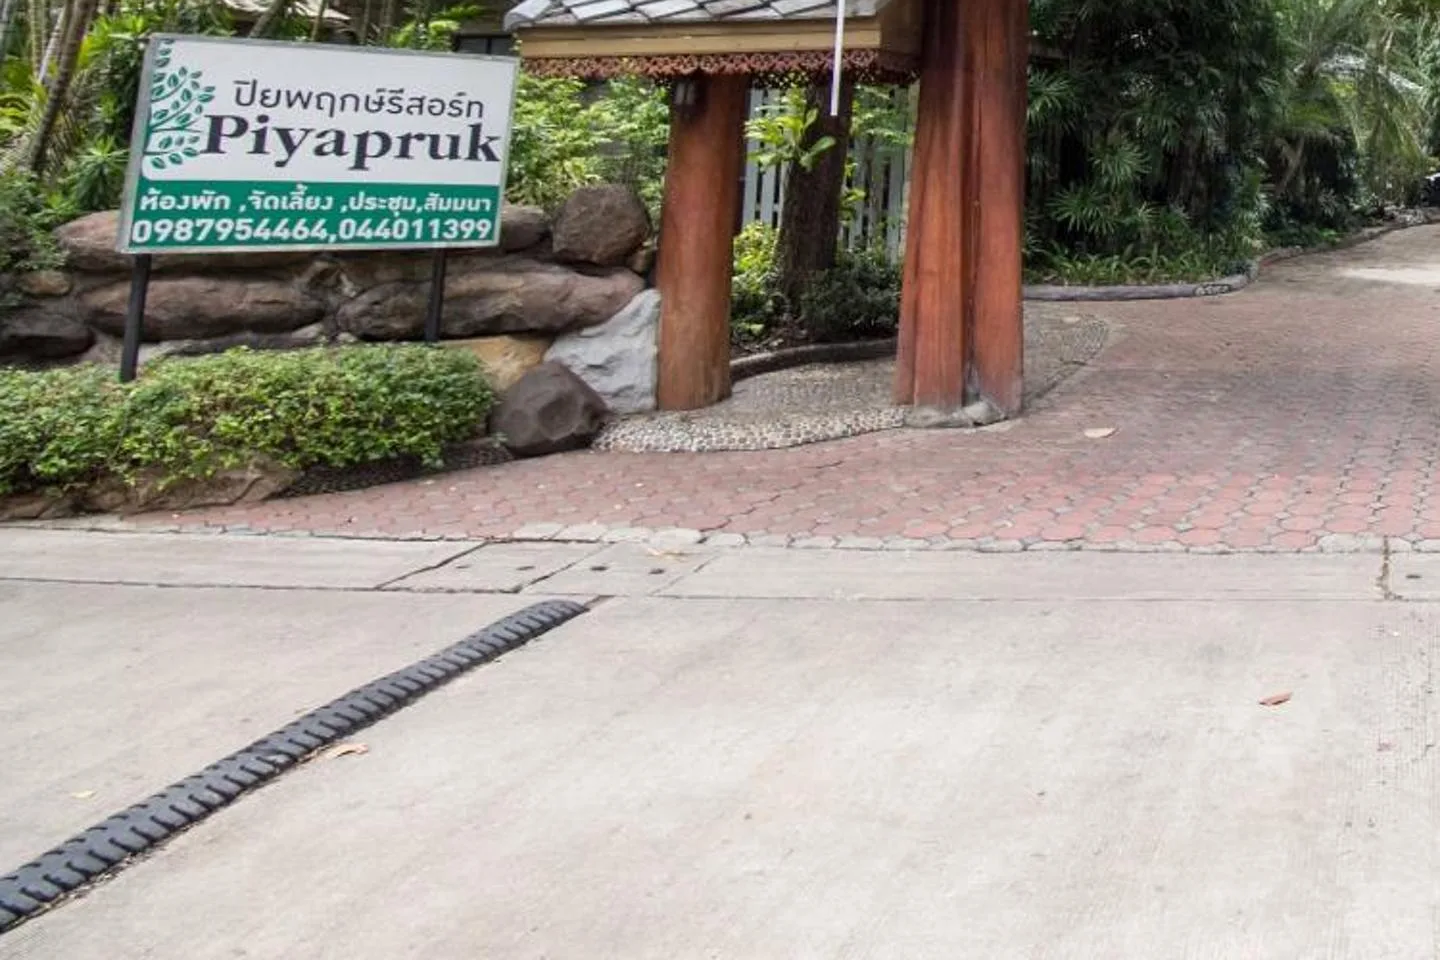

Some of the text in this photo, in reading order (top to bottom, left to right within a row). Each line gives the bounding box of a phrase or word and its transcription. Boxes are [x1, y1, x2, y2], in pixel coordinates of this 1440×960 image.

[233, 79, 485, 119] ปิยพฤกษ์รีสอร์ท
[203, 113, 501, 171] Piyapruk
[139, 187, 232, 211] ห้องพัก
[131, 217, 493, 244] 0987954464,044011399
